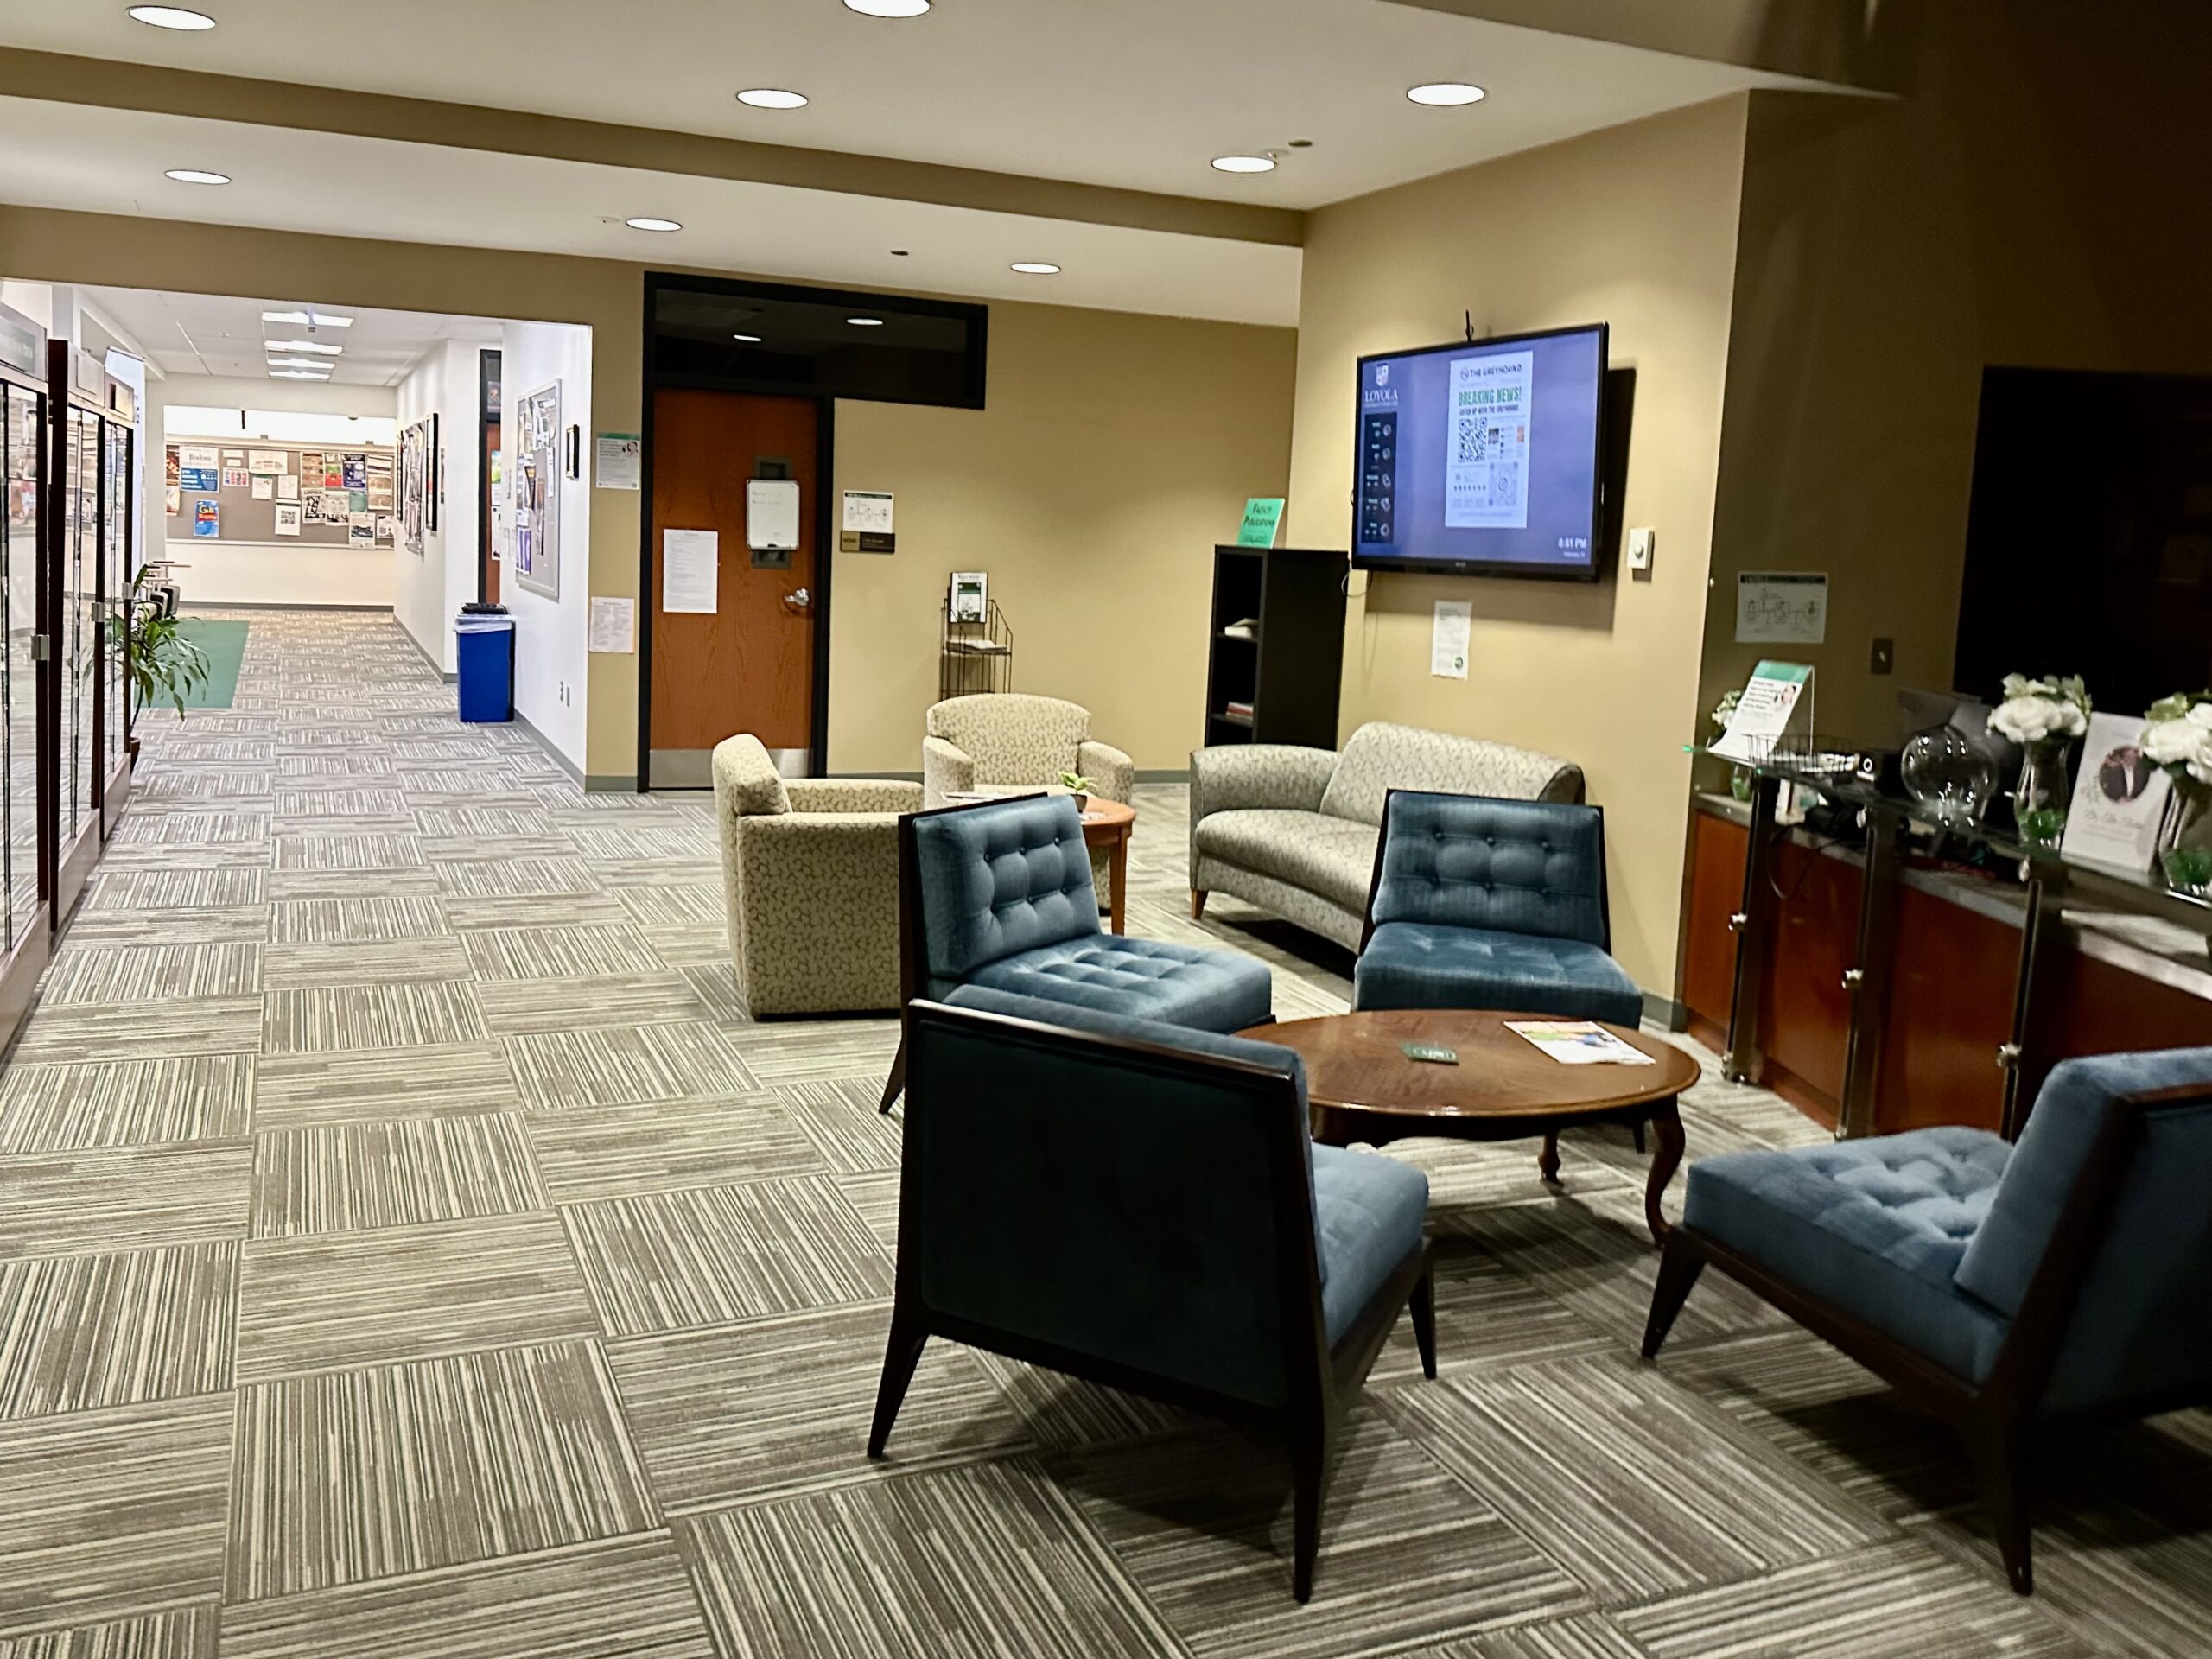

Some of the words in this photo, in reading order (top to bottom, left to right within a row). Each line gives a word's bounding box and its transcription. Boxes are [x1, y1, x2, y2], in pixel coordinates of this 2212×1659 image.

[1470, 368, 1481, 377] THE
[1483, 364, 1522, 376] GREYHOUND
[1365, 389, 1398, 402] LOYOLA
[1459, 389, 1494, 406] BREAKING
[1497, 386, 1522, 403] NEWS!
[1574, 537, 1586, 549] PM
